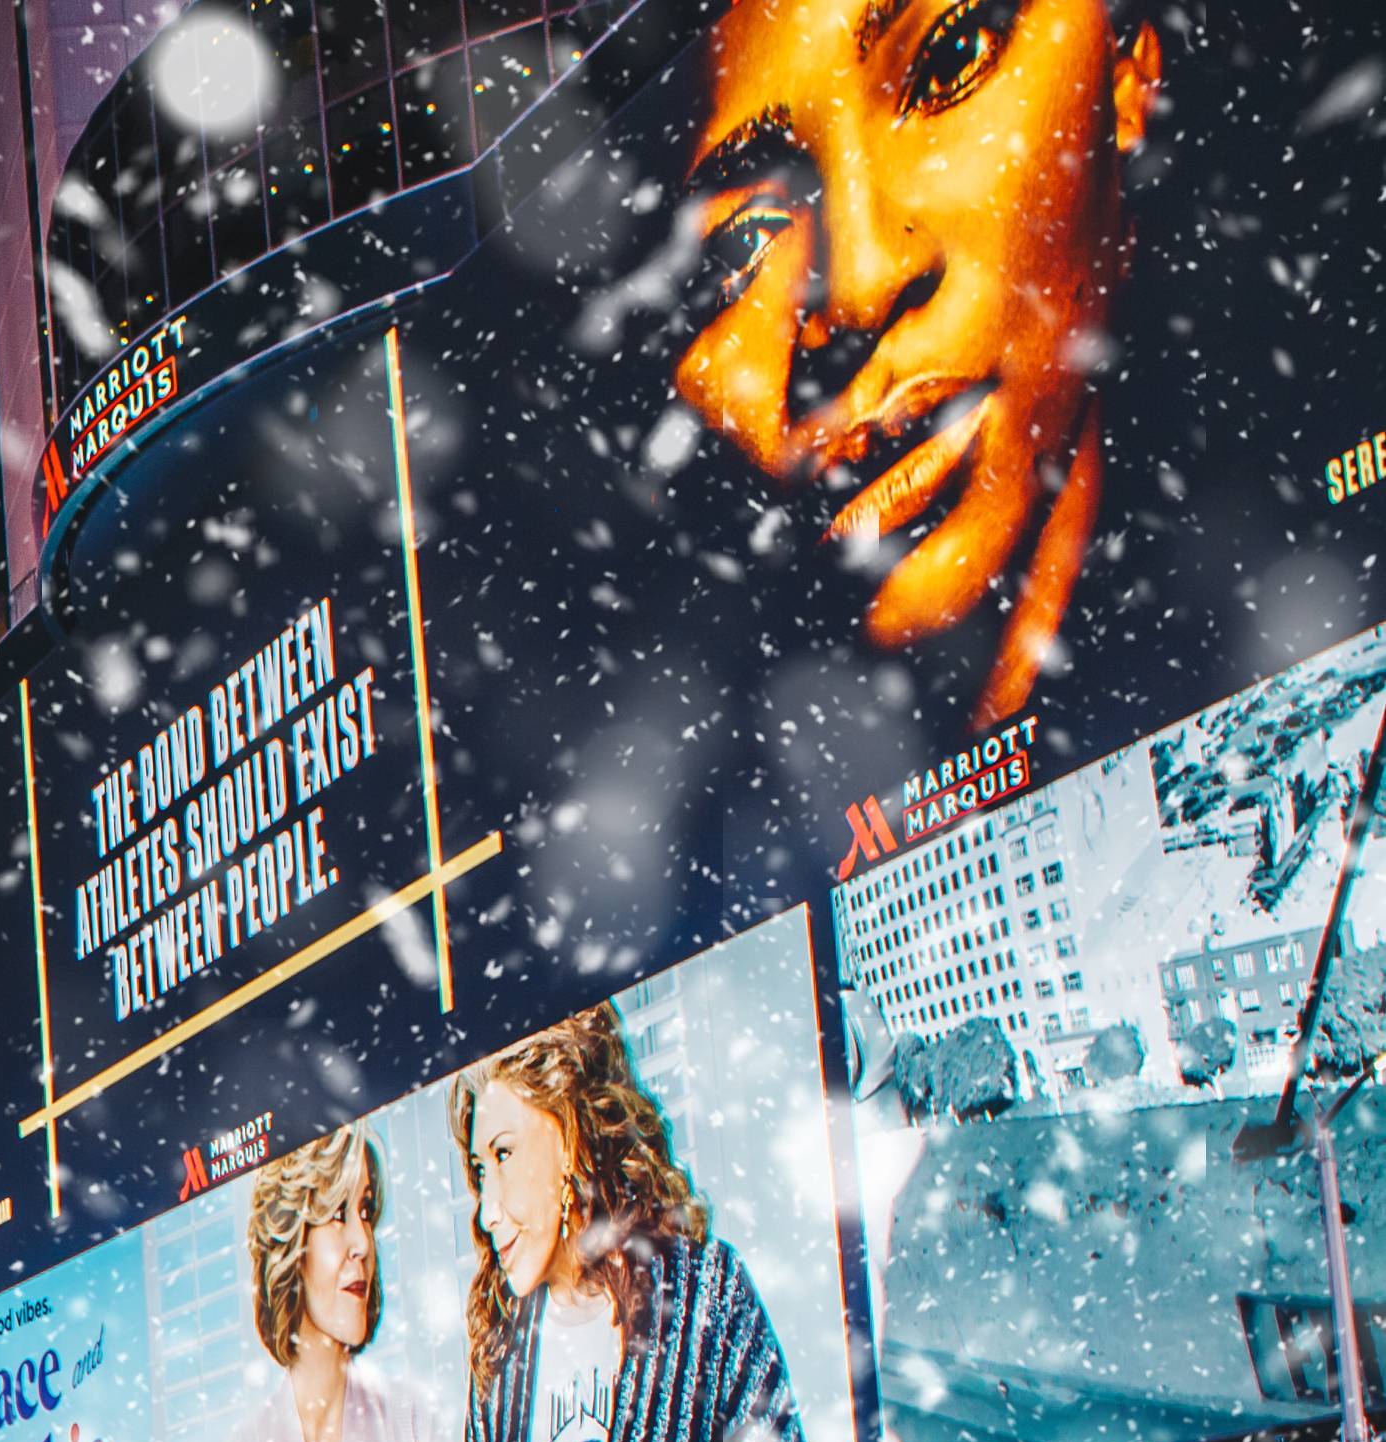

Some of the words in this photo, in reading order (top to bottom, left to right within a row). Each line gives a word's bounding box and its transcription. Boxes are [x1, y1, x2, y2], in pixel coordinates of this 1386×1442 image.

[69, 317, 187, 436] MARRIOTT
[71, 366, 174, 473] MARQUIS
[91, 759, 137, 857] THE
[139, 705, 206, 825] BOND
[209, 598, 337, 770] BETWEEN
[903, 716, 1038, 805] MARRIOTT
[75, 827, 181, 961] ATHLETES
[184, 737, 288, 881] SHOULD
[292, 667, 377, 801] EXIST
[906, 757, 1026, 840] MARQUIS
[111, 880, 225, 1023] BETWEEN
[227, 807, 340, 948] PEOPLE.
[209, 1111, 273, 1158] MARRIOTT
[210, 1139, 267, 1181] MARQUIS
[16, 1298, 52, 1327] vibes.
[72, 1322, 105, 1389] and
